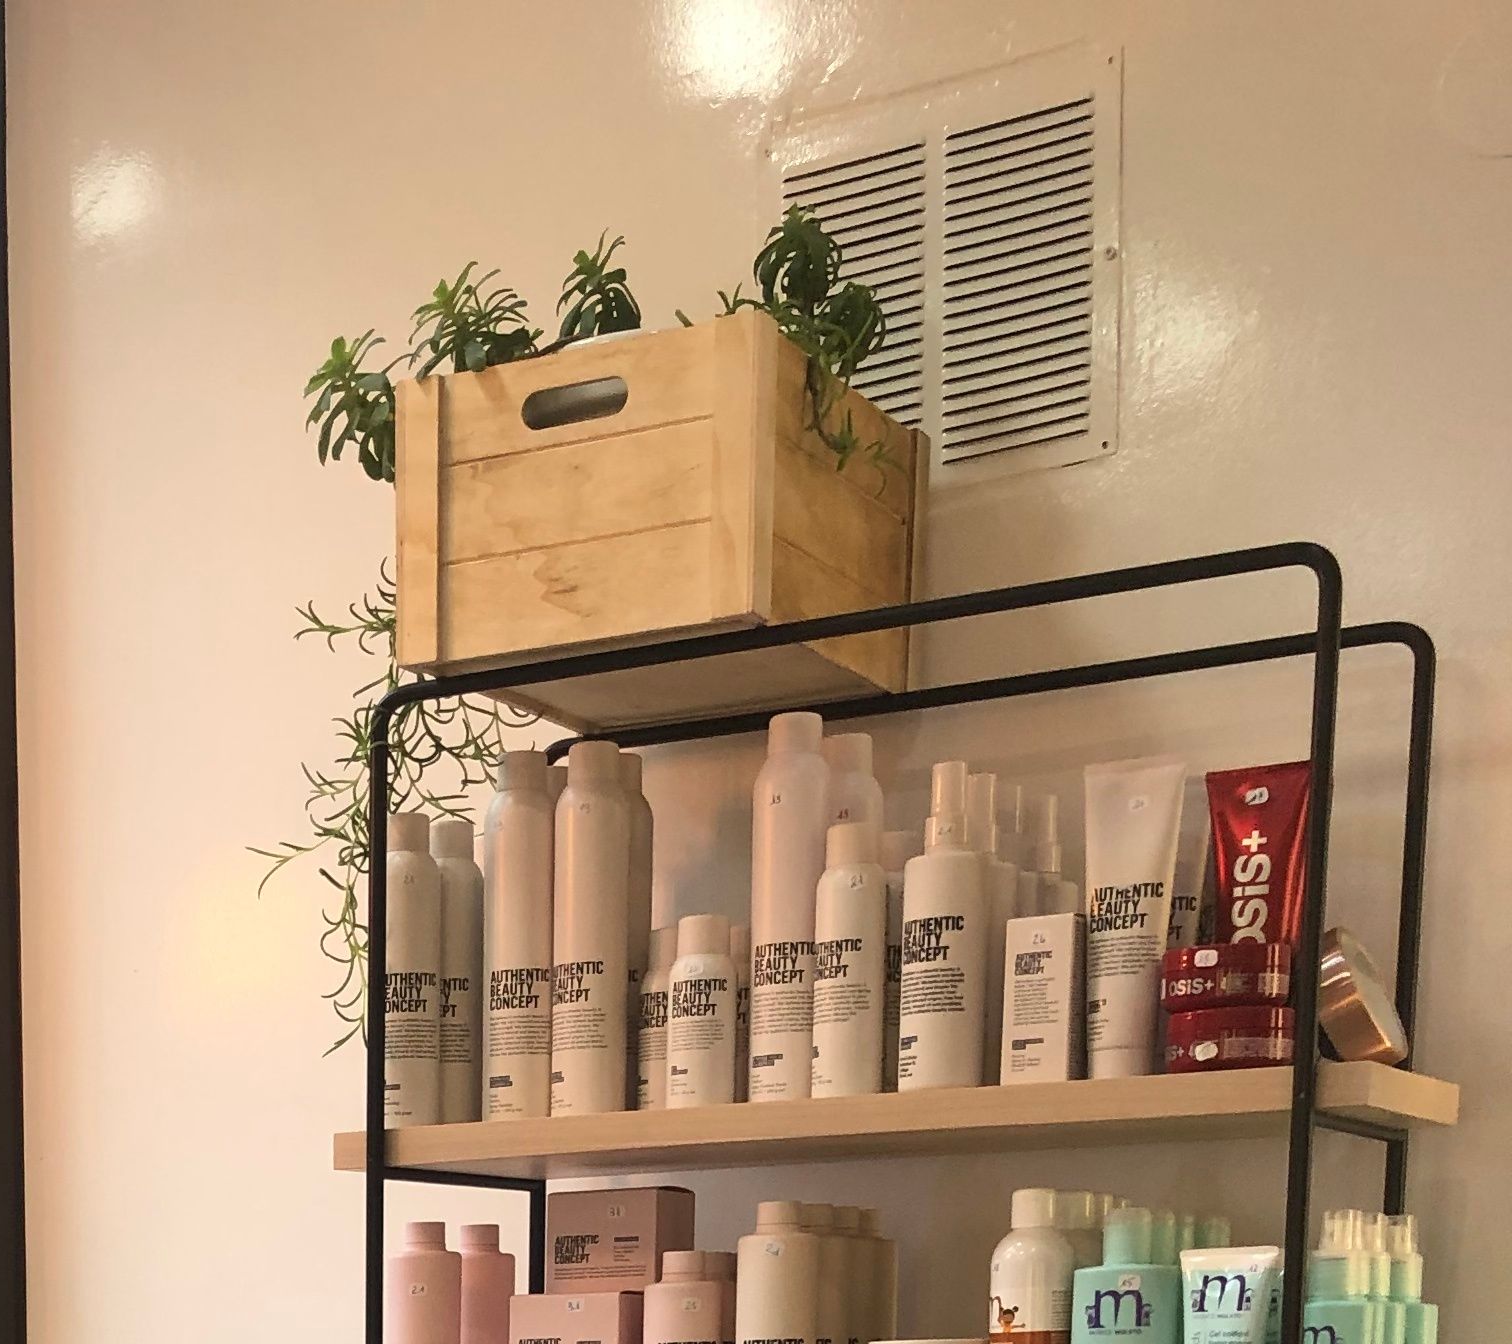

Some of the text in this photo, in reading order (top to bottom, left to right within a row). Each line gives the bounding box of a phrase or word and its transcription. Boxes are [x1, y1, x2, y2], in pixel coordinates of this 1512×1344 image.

[1092, 882, 1164, 902] AUTHENTIC
[1090, 913, 1148, 934] CONCEPT
[903, 946, 950, 964] CONCEPT
[754, 956, 798, 972] BEAUTY
[384, 972, 436, 987] UTHENTIC
[490, 968, 550, 984] AUTHENTIC
[754, 970, 805, 987] CONCEPT
[384, 986, 422, 1000] EAUTY
[490, 982, 532, 997] BEAUTY
[672, 978, 728, 994] AUTHENTIC
[490, 995, 540, 1011] CONCEPT
[672, 992, 712, 1006] BEAUTY
[384, 1000, 428, 1014] ONCEPT
[672, 1004, 717, 1018] CONCEPT
[554, 1234, 599, 1245] AUTHENTIC
[554, 1244, 588, 1255] BEAUTY
[554, 1254, 590, 1264] CONCEPT
